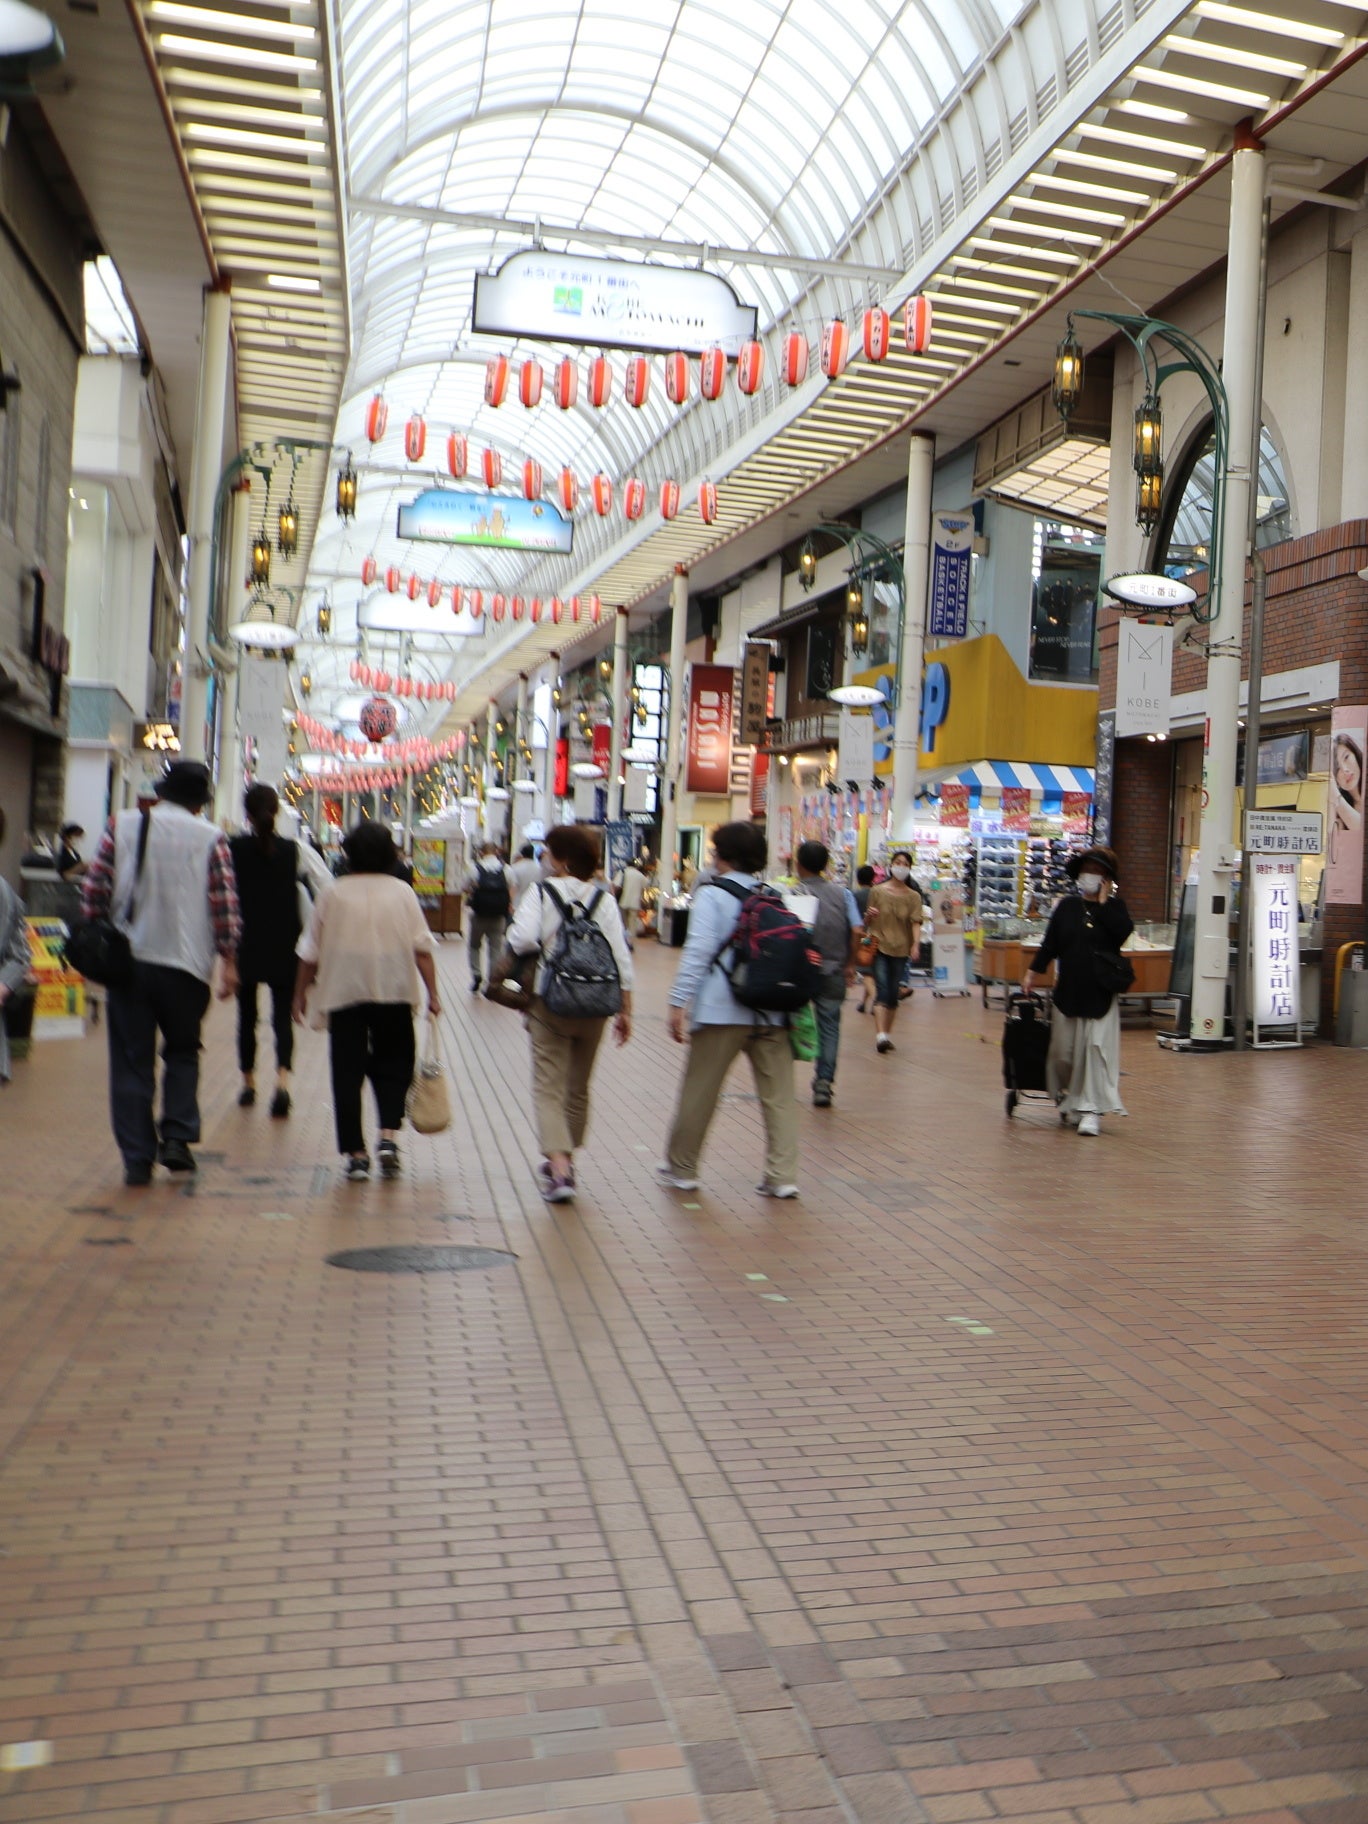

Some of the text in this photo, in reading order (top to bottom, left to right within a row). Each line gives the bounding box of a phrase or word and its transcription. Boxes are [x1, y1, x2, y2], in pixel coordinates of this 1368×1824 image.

[959, 559, 968, 592] TRACK
[936, 555, 946, 632] BASKETBALL
[945, 557, 958, 633] SOCCER
[956, 602, 965, 634] FIELD
[1126, 697, 1161, 709] KOBE
[1250, 835, 1319, 851] 元町時計店
[1268, 882, 1292, 1017] 元町時計店
